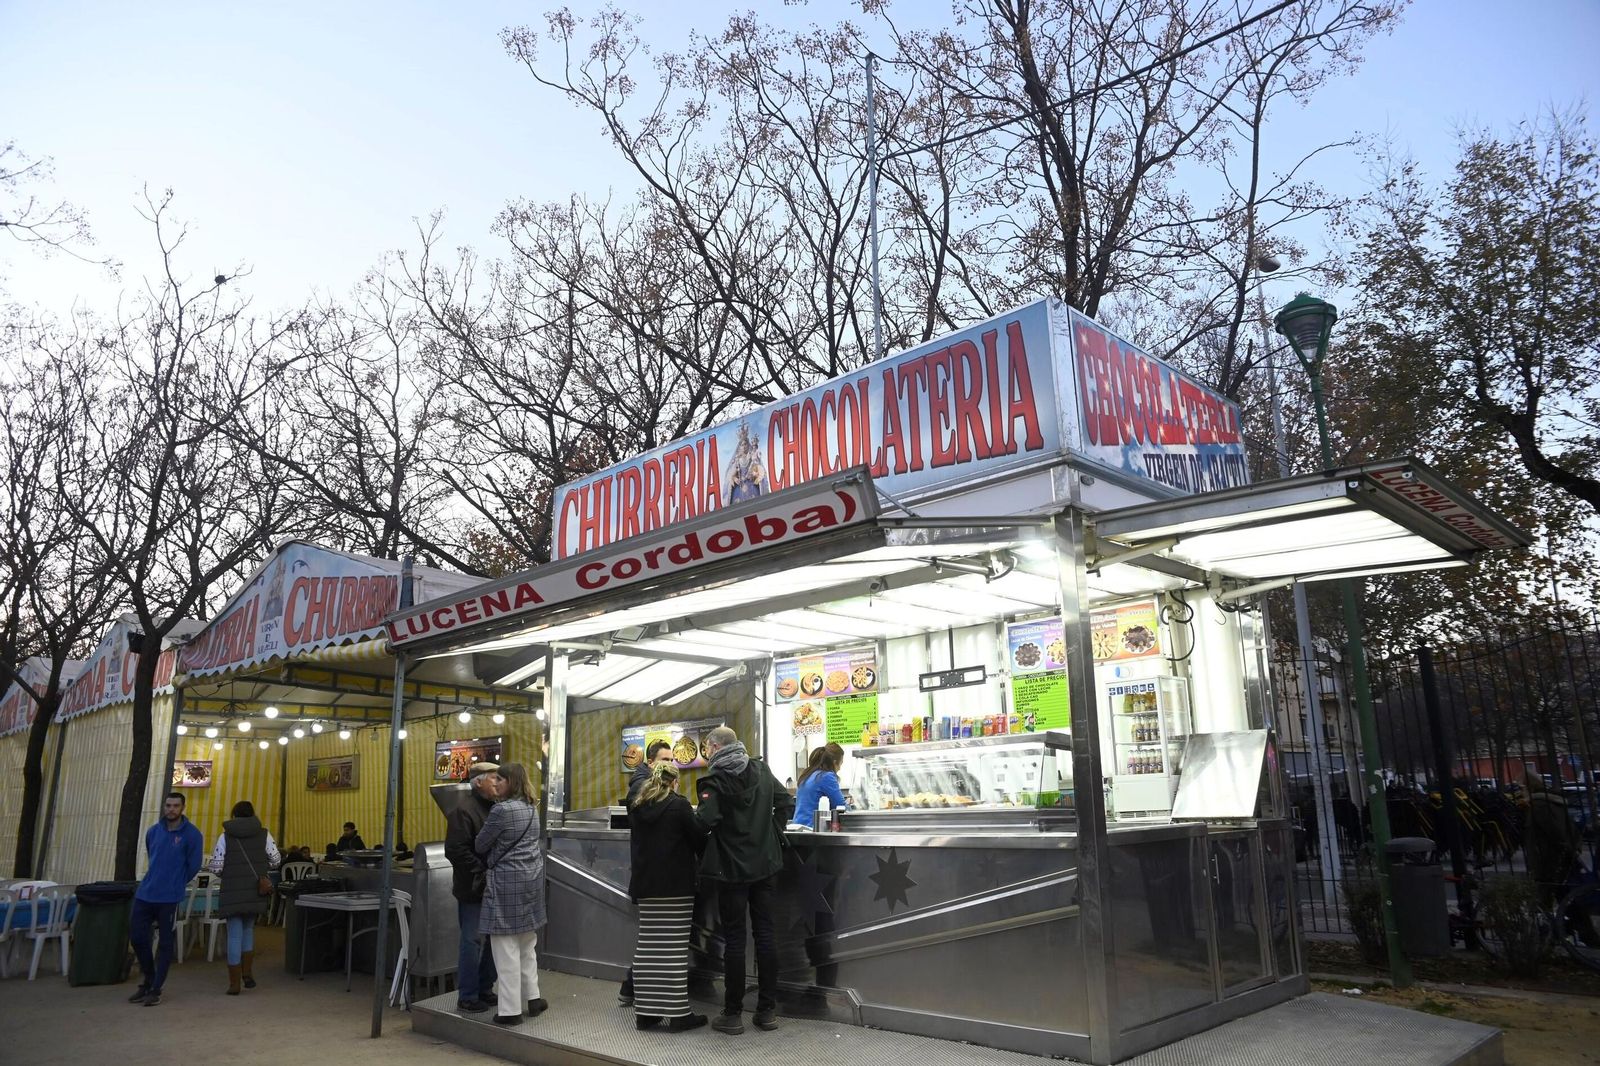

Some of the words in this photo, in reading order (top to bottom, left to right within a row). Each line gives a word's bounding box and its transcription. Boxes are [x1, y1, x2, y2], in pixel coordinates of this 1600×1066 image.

[558, 433, 723, 560] CHURRERIA
[767, 320, 1044, 493] CHOCOLATERIA
[1143, 453, 1190, 493] VIRGEN
[1369, 465, 1458, 512] LUCENA
[387, 583, 544, 642] LUCENA
[576, 491, 857, 590] Cordoba)
[284, 574, 399, 648] CHURRERIA
